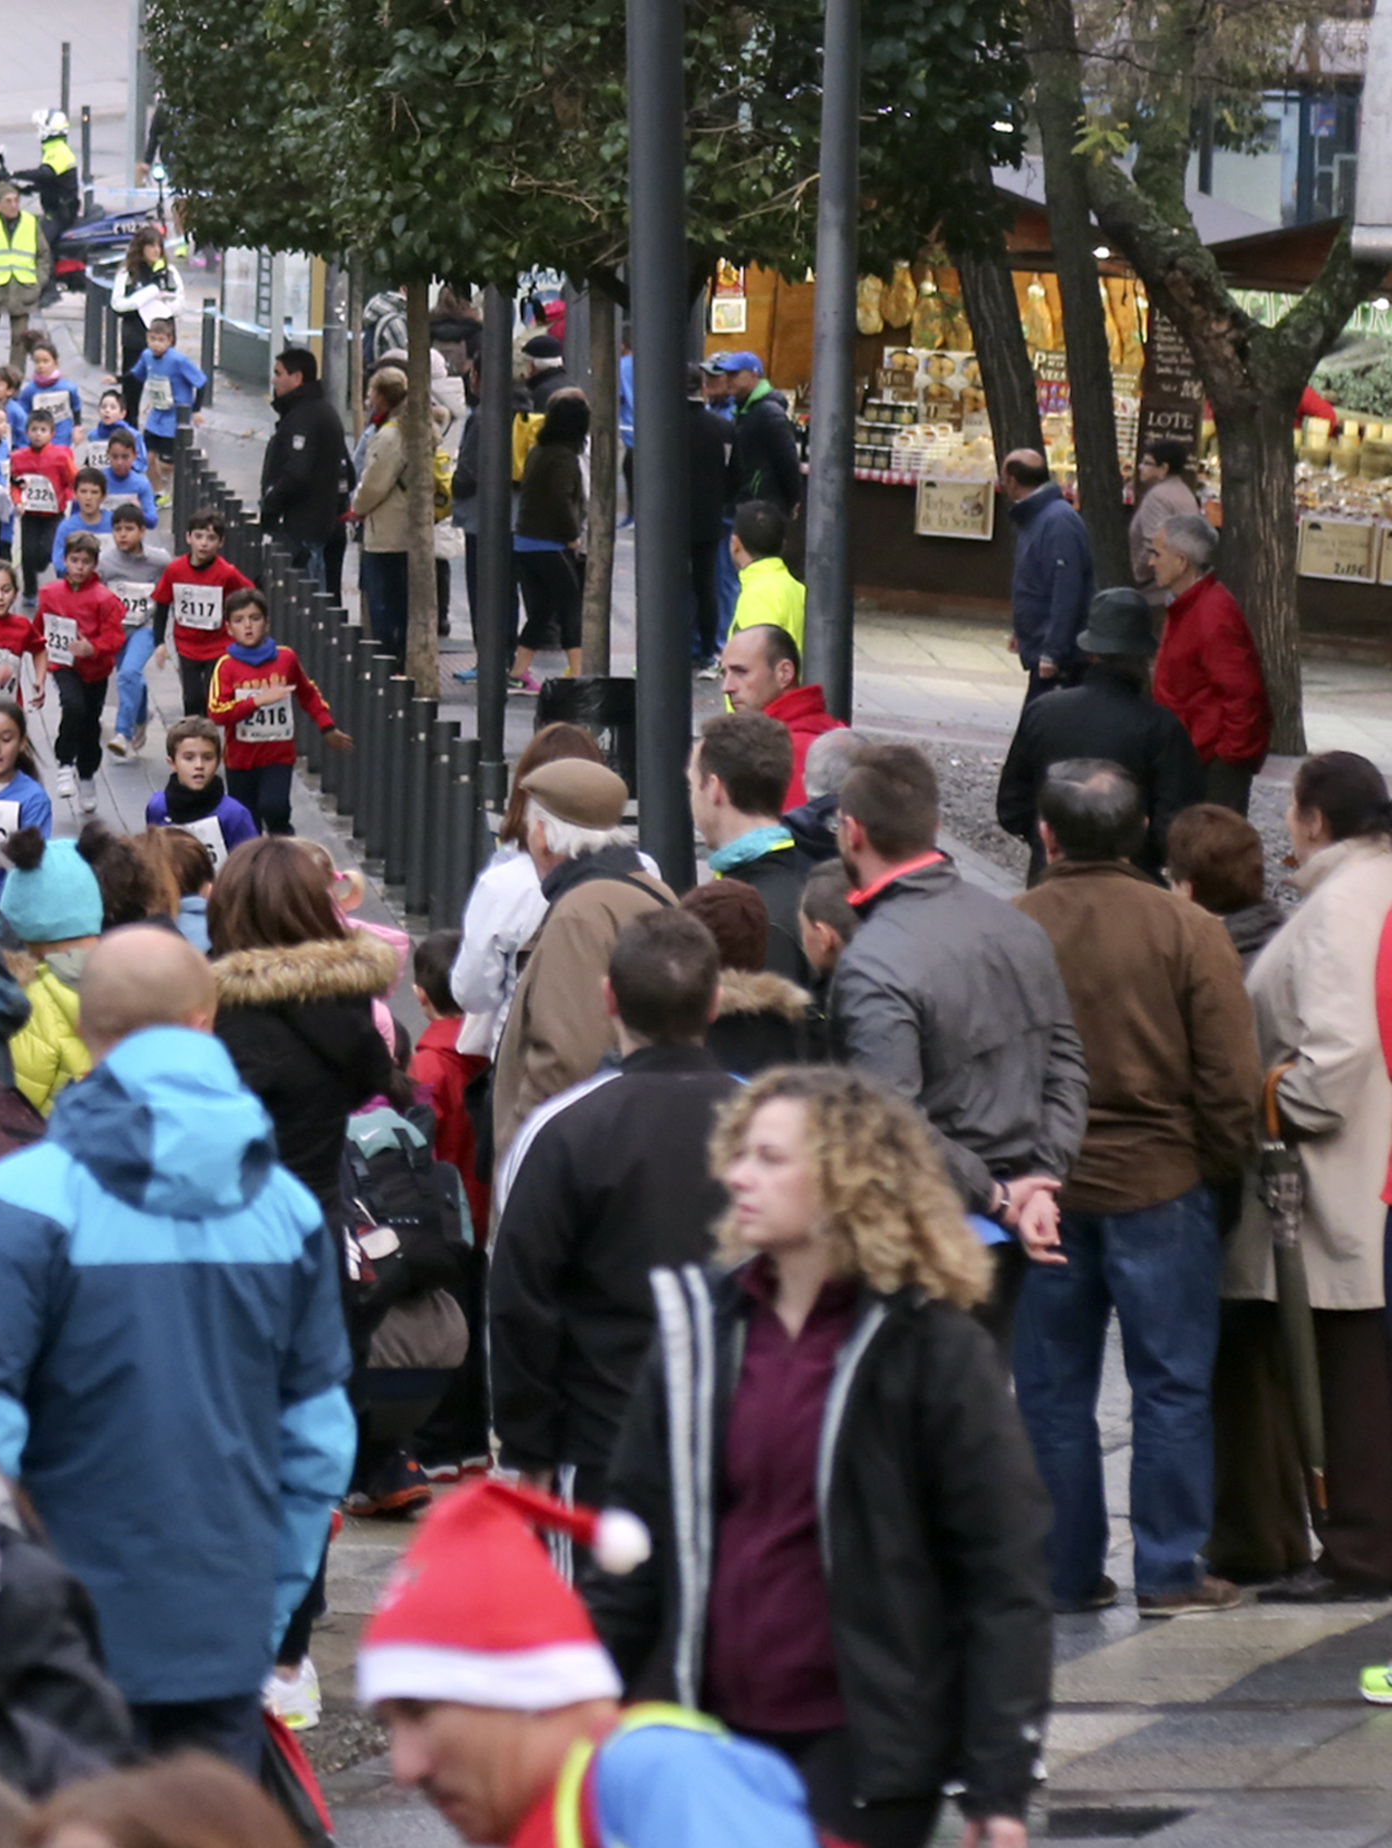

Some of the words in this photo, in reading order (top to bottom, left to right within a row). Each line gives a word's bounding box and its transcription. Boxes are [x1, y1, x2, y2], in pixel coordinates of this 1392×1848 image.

[91, 454, 111, 465] 242
[122, 598, 148, 613] 079
[181, 600, 215, 617] 2117
[48, 632, 74, 651] 233
[244, 706, 287, 726] 2416
